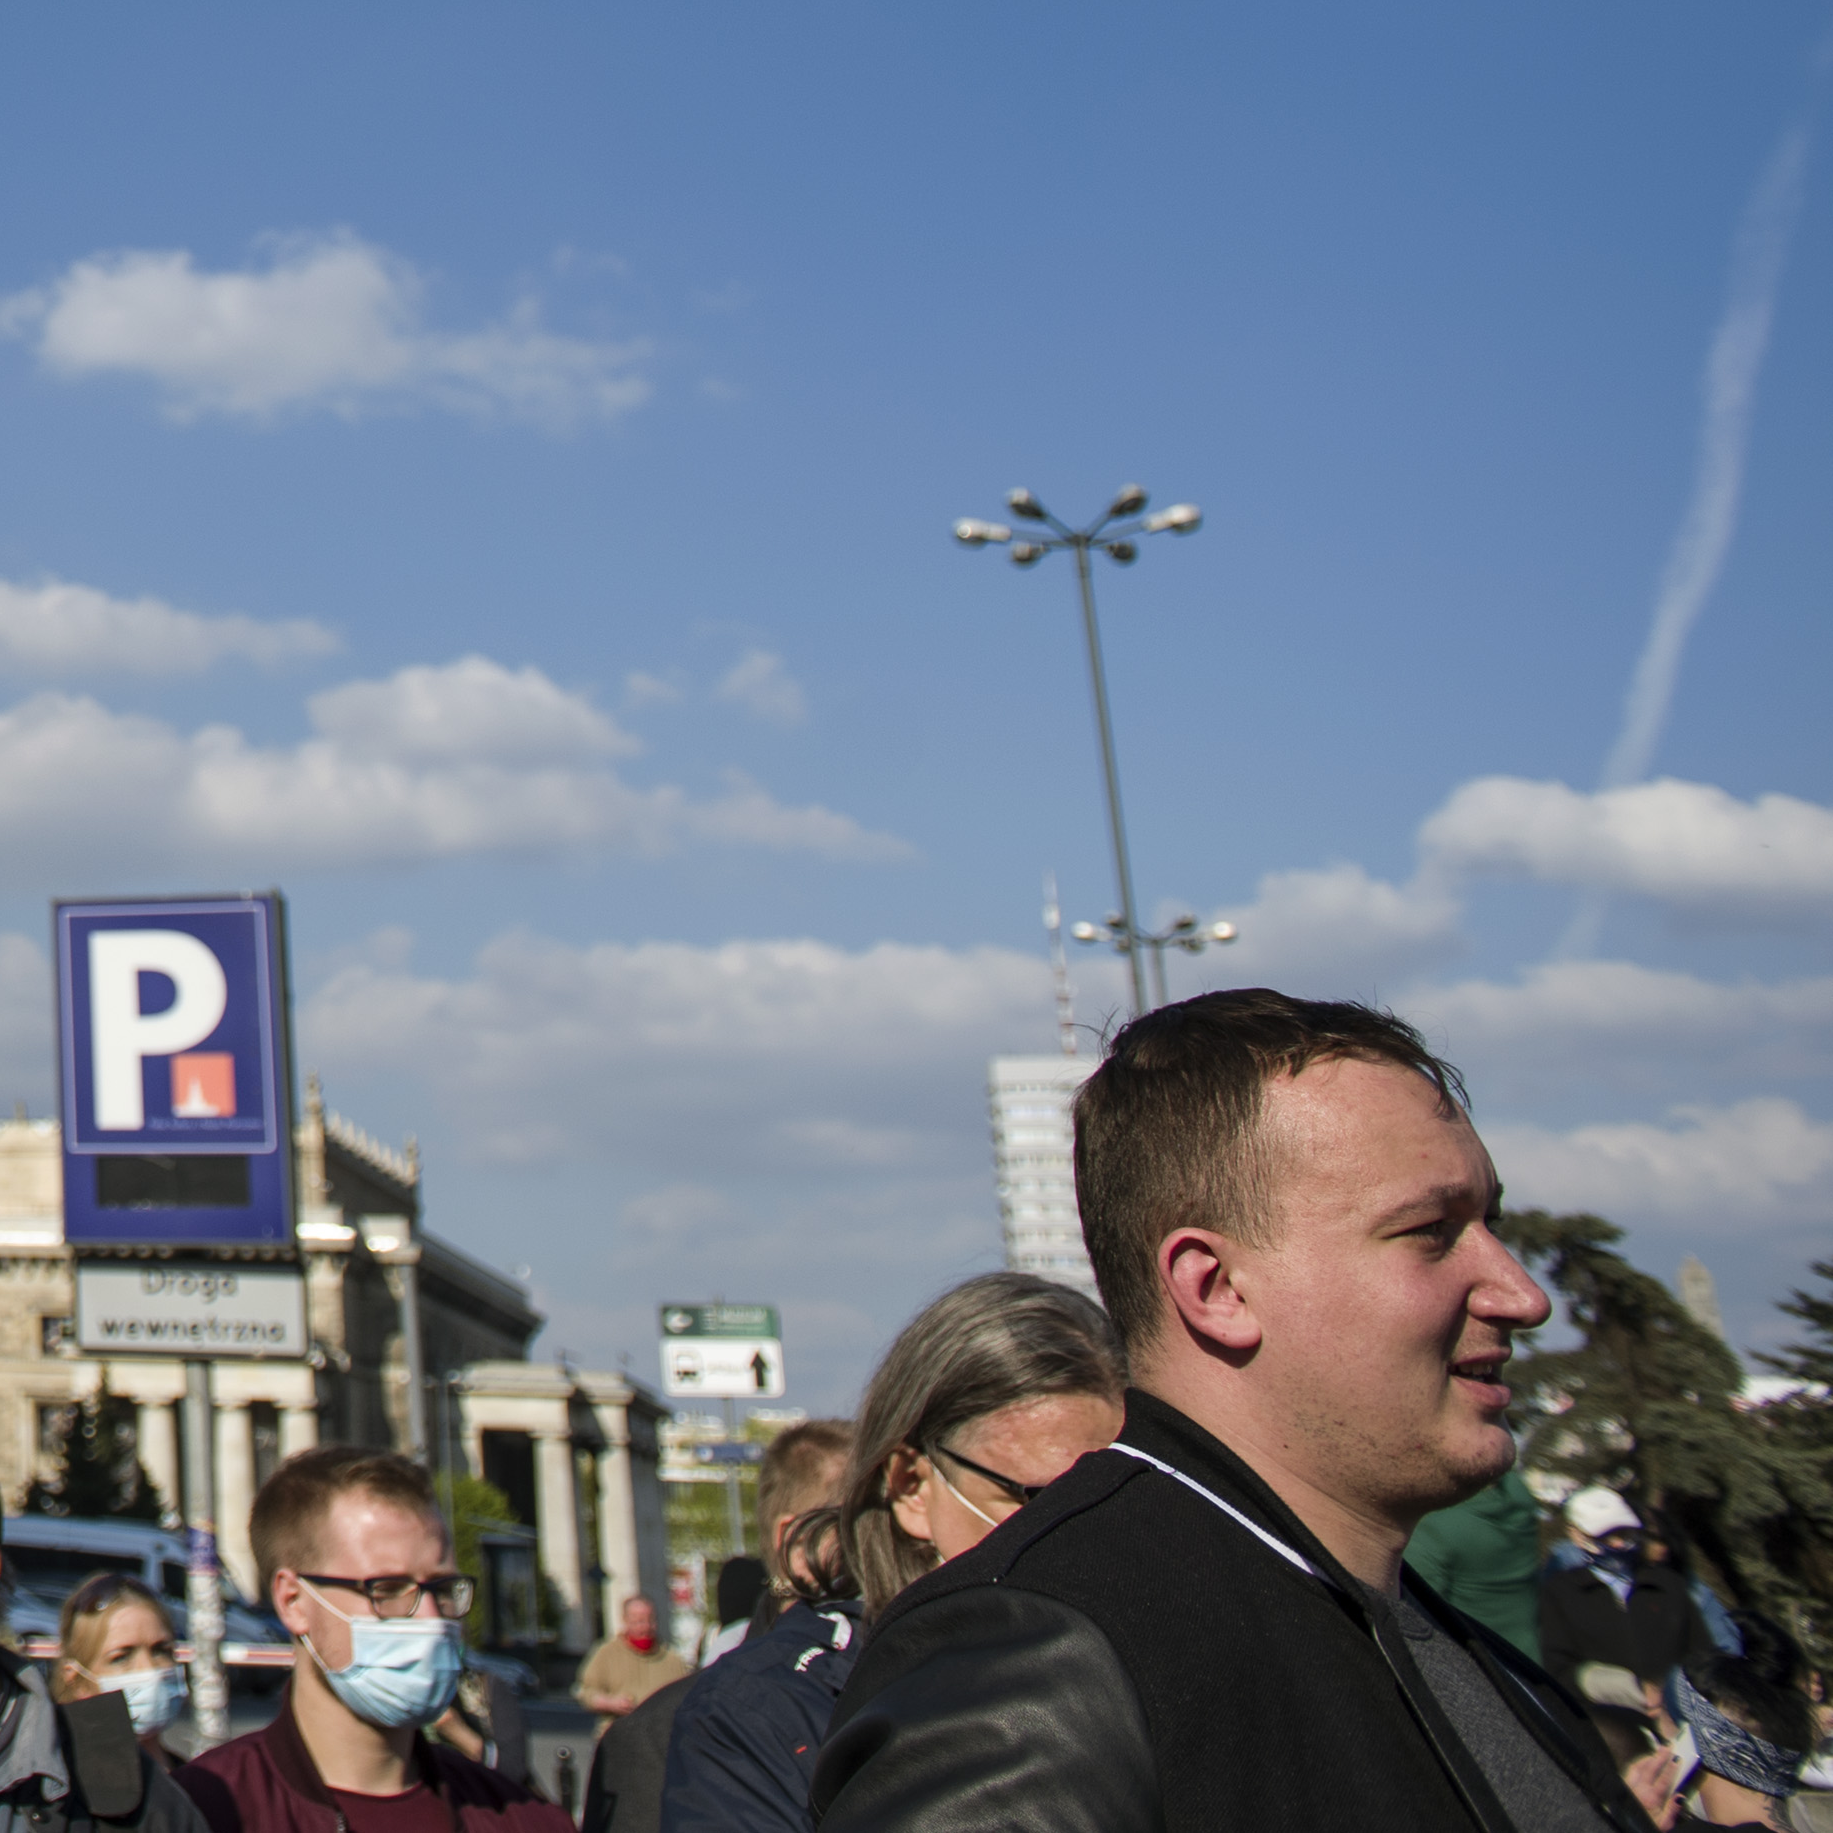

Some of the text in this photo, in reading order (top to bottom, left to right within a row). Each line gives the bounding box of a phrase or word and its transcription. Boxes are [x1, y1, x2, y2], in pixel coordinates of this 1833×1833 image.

[88, 929, 227, 1131] P
[139, 1268, 238, 1304] Droga
[99, 1317, 286, 1349] wewnętrzna
